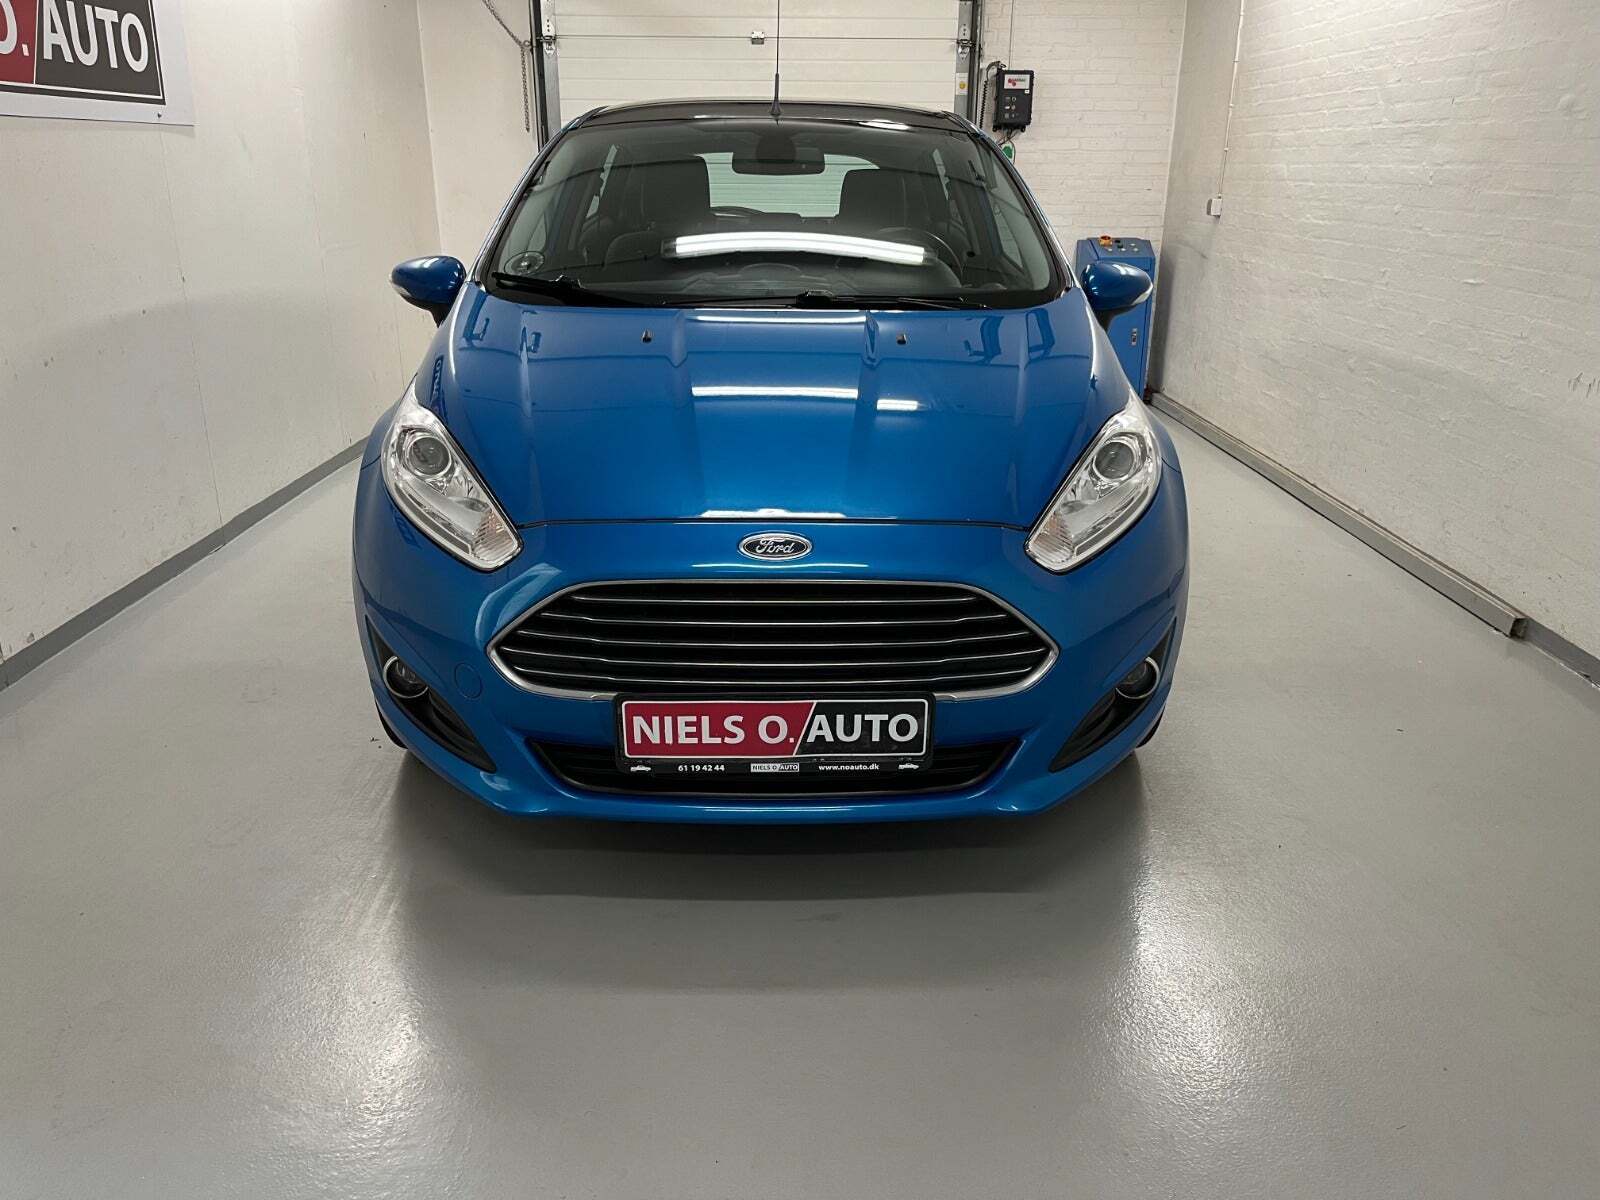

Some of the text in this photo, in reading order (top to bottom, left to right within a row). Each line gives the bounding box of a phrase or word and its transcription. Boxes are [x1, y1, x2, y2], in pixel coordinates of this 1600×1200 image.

[43, 0, 149, 73] AUTO
[755, 537, 795, 554] Ford
[632, 713, 919, 745] NIELS O. AUTO
[678, 764, 725, 772] 61 19 42 44
[819, 763, 880, 771] www.noauto.dk
